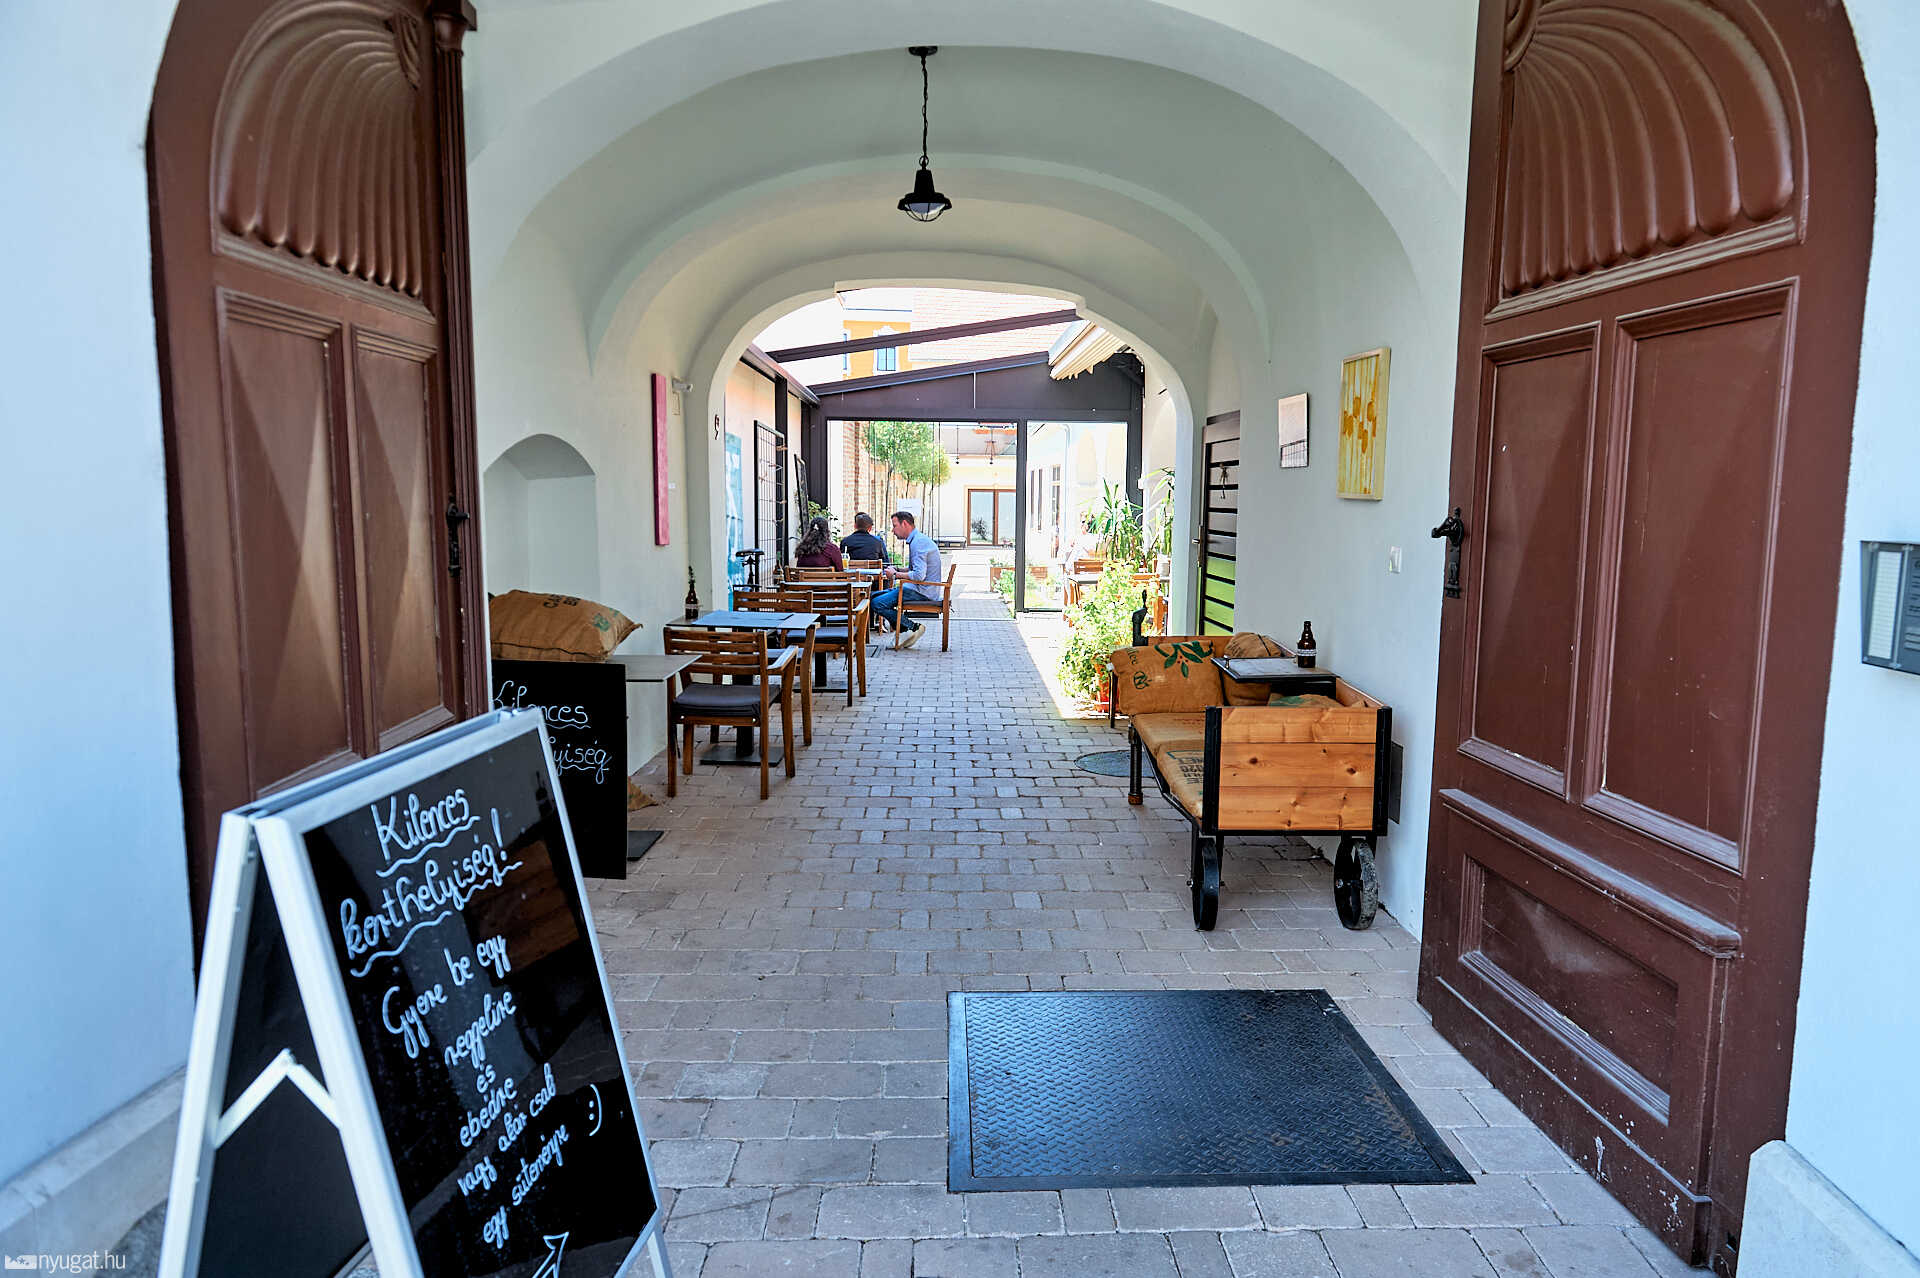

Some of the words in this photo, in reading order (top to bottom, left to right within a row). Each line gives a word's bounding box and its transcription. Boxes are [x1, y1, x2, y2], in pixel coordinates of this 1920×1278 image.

[371, 789, 469, 861] Kilences
[340, 807, 508, 960] korthelyiség!
[382, 983, 448, 1059] Gyere
[443, 948, 474, 986] be
[476, 935, 511, 979] egy
[444, 991, 517, 1069] reggelire
[459, 1077, 517, 1147] ebédre
[476, 1062, 497, 1093] és
[457, 1155, 498, 1196] vagy
[498, 1103, 528, 1152] akár
[529, 1062, 557, 1118] csak
[483, 1204, 510, 1249] egy
